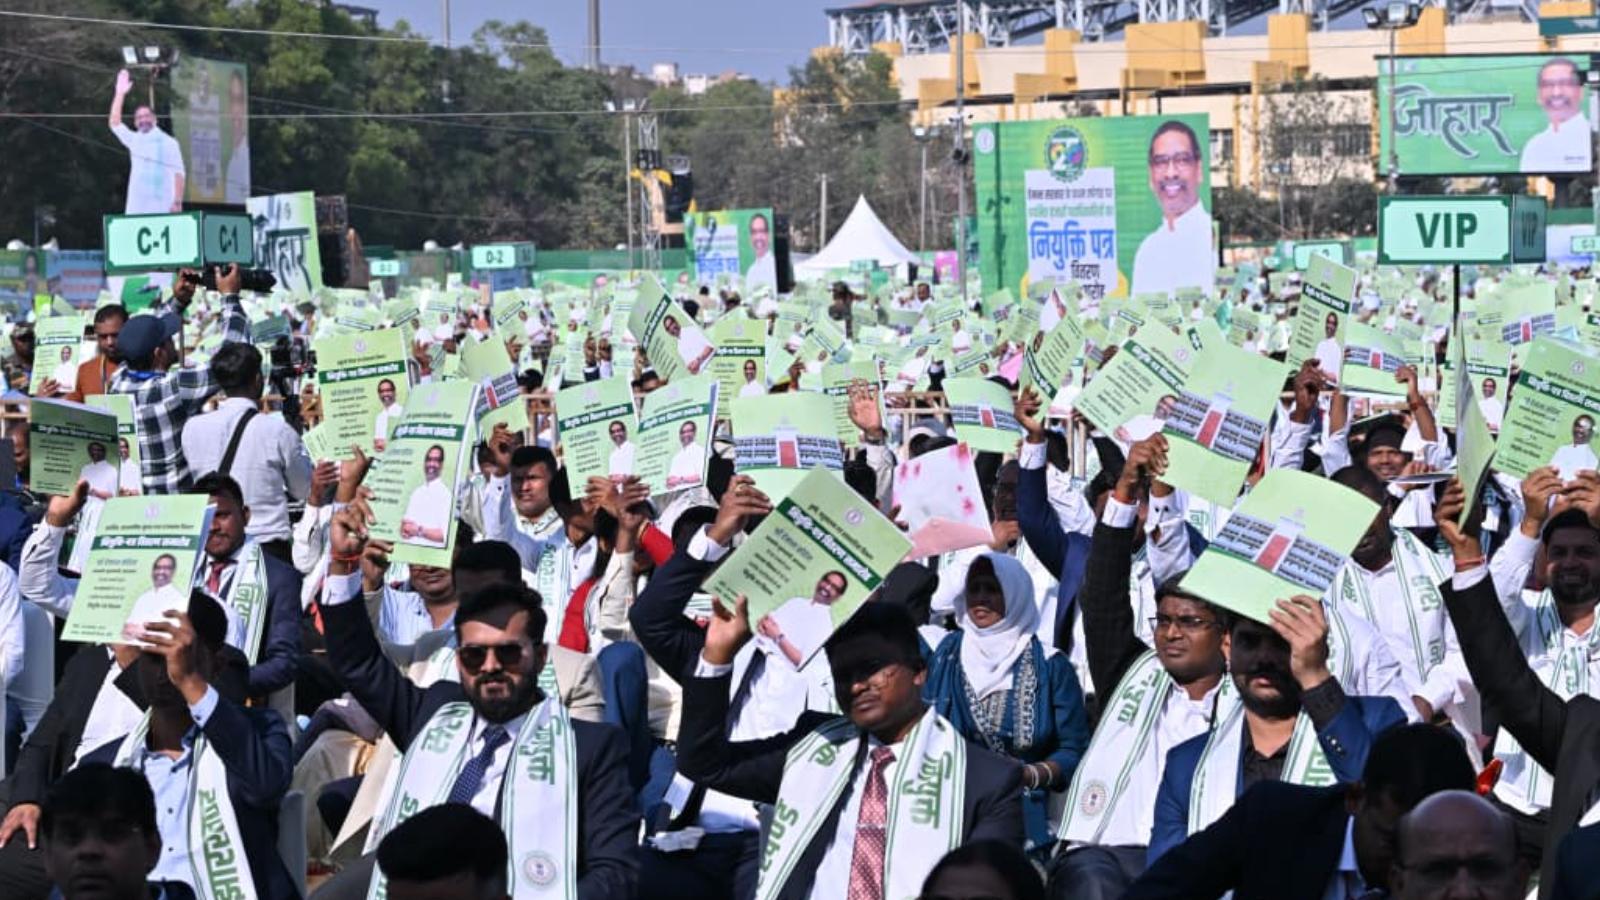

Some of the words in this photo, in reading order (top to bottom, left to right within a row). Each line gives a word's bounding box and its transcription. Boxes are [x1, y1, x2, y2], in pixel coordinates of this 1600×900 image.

[137, 226, 170, 255] C-1
[219, 224, 239, 254] C-1
[1029, 220, 1087, 270] नियुक्ति
[1089, 228, 1115, 260] पत्र
[1415, 212, 1478, 248] VIP
[1520, 211, 1538, 248] VIP
